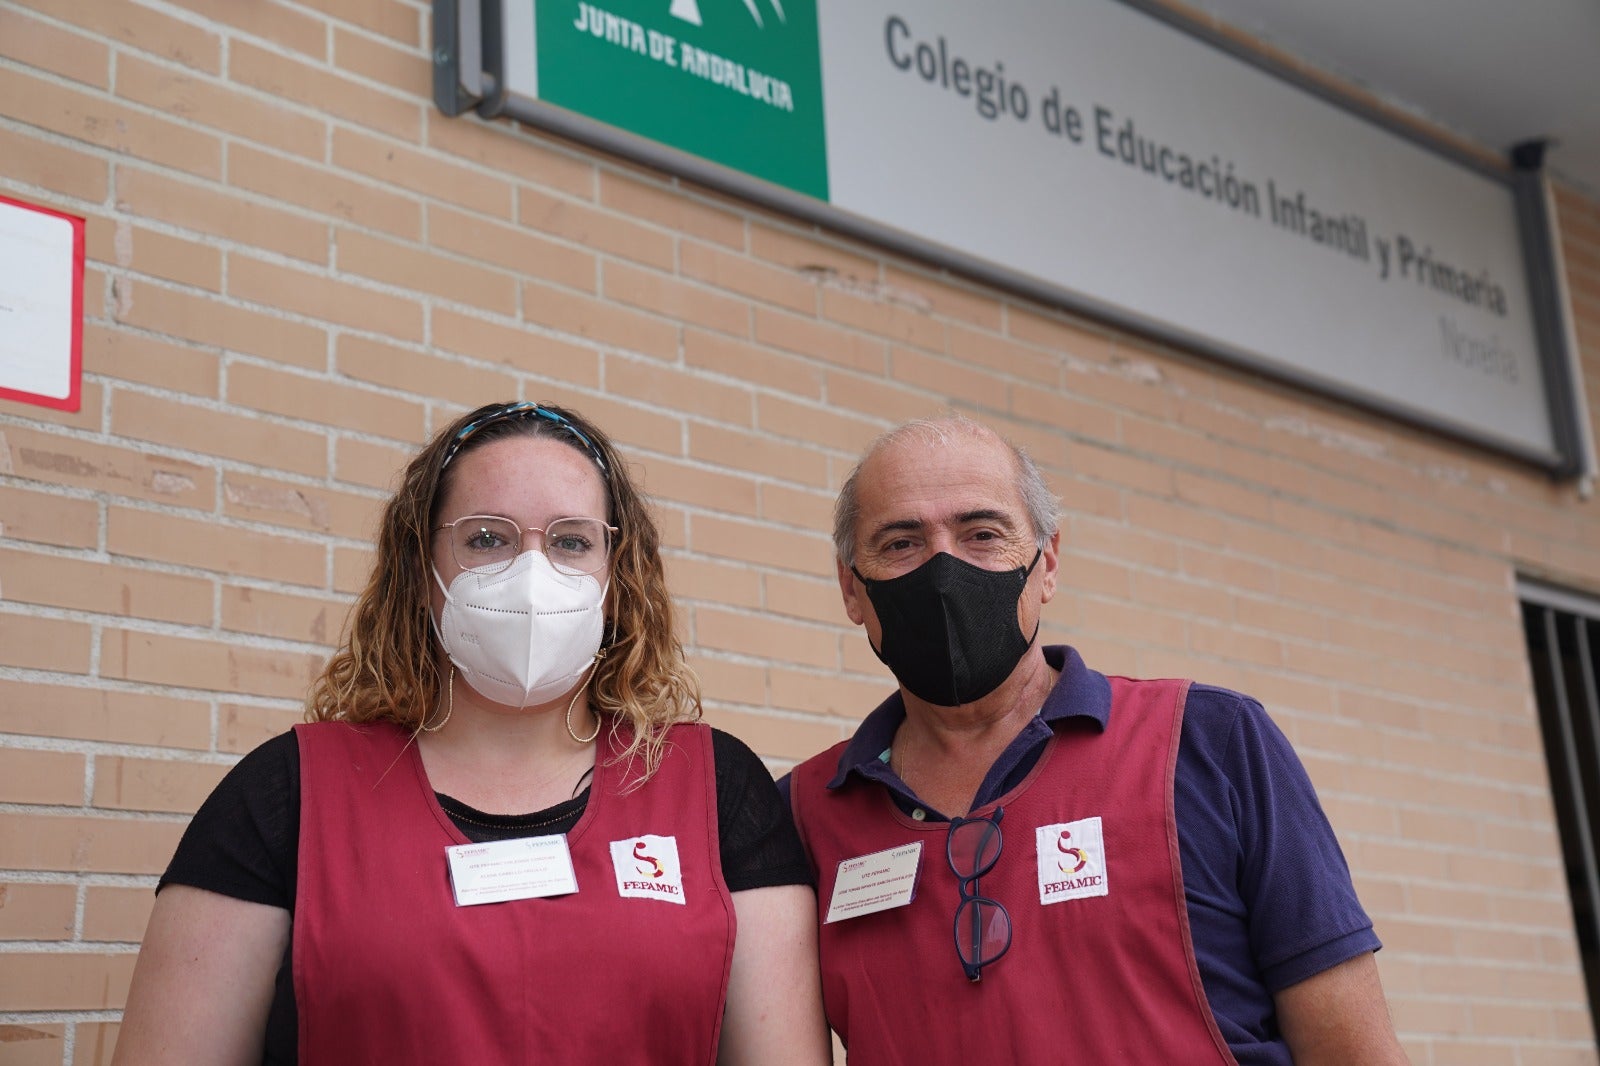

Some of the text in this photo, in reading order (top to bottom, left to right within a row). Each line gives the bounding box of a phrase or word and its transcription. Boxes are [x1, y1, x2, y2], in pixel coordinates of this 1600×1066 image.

[573, 1, 647, 55] JUNTA
[648, 29, 678, 67] DE
[884, 15, 1508, 317] Colegio de Educación Infantil y Primaria
[623, 881, 679, 895] FEPAMIC
[1044, 875, 1102, 895] FEPAMIC
